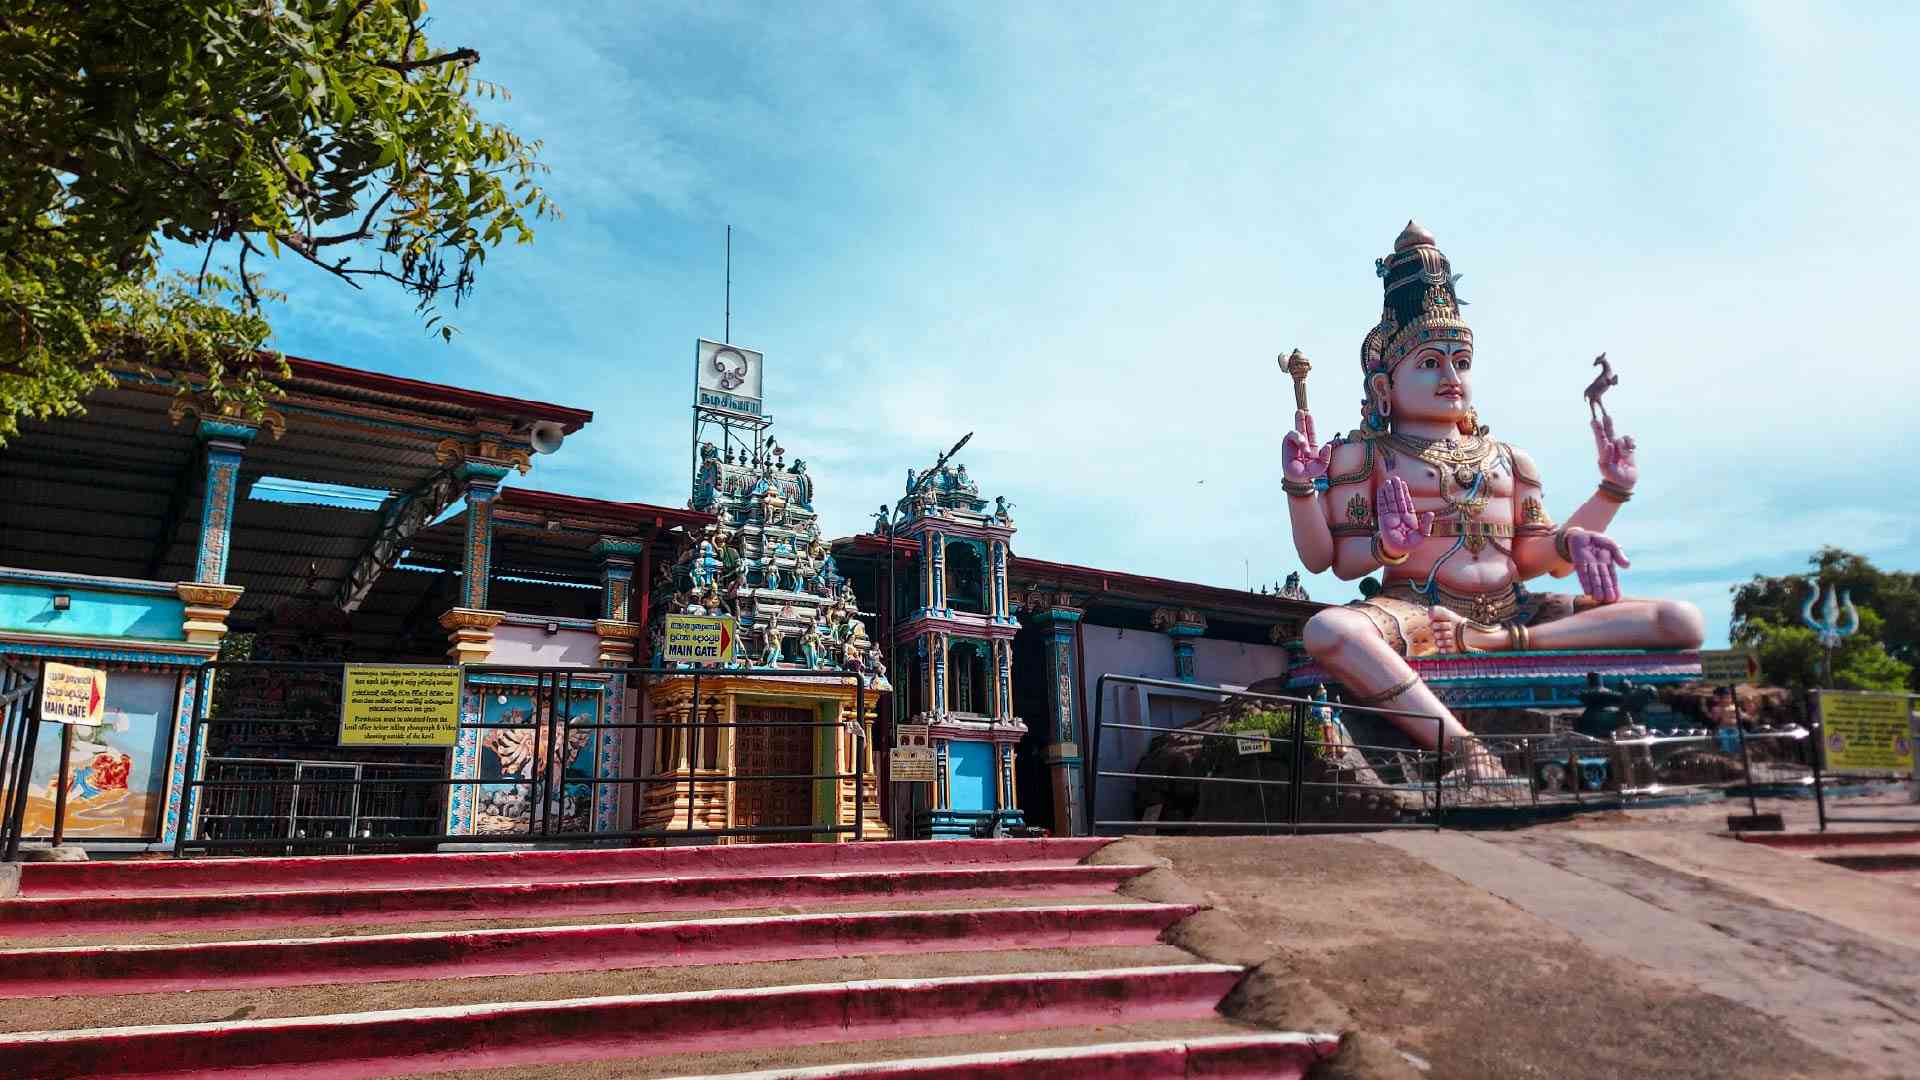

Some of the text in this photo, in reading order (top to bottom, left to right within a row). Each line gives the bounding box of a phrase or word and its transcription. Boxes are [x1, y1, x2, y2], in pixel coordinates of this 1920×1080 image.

[669, 644, 718, 657] MAIN GATE
[44, 701, 87, 718] MAIN GATE
